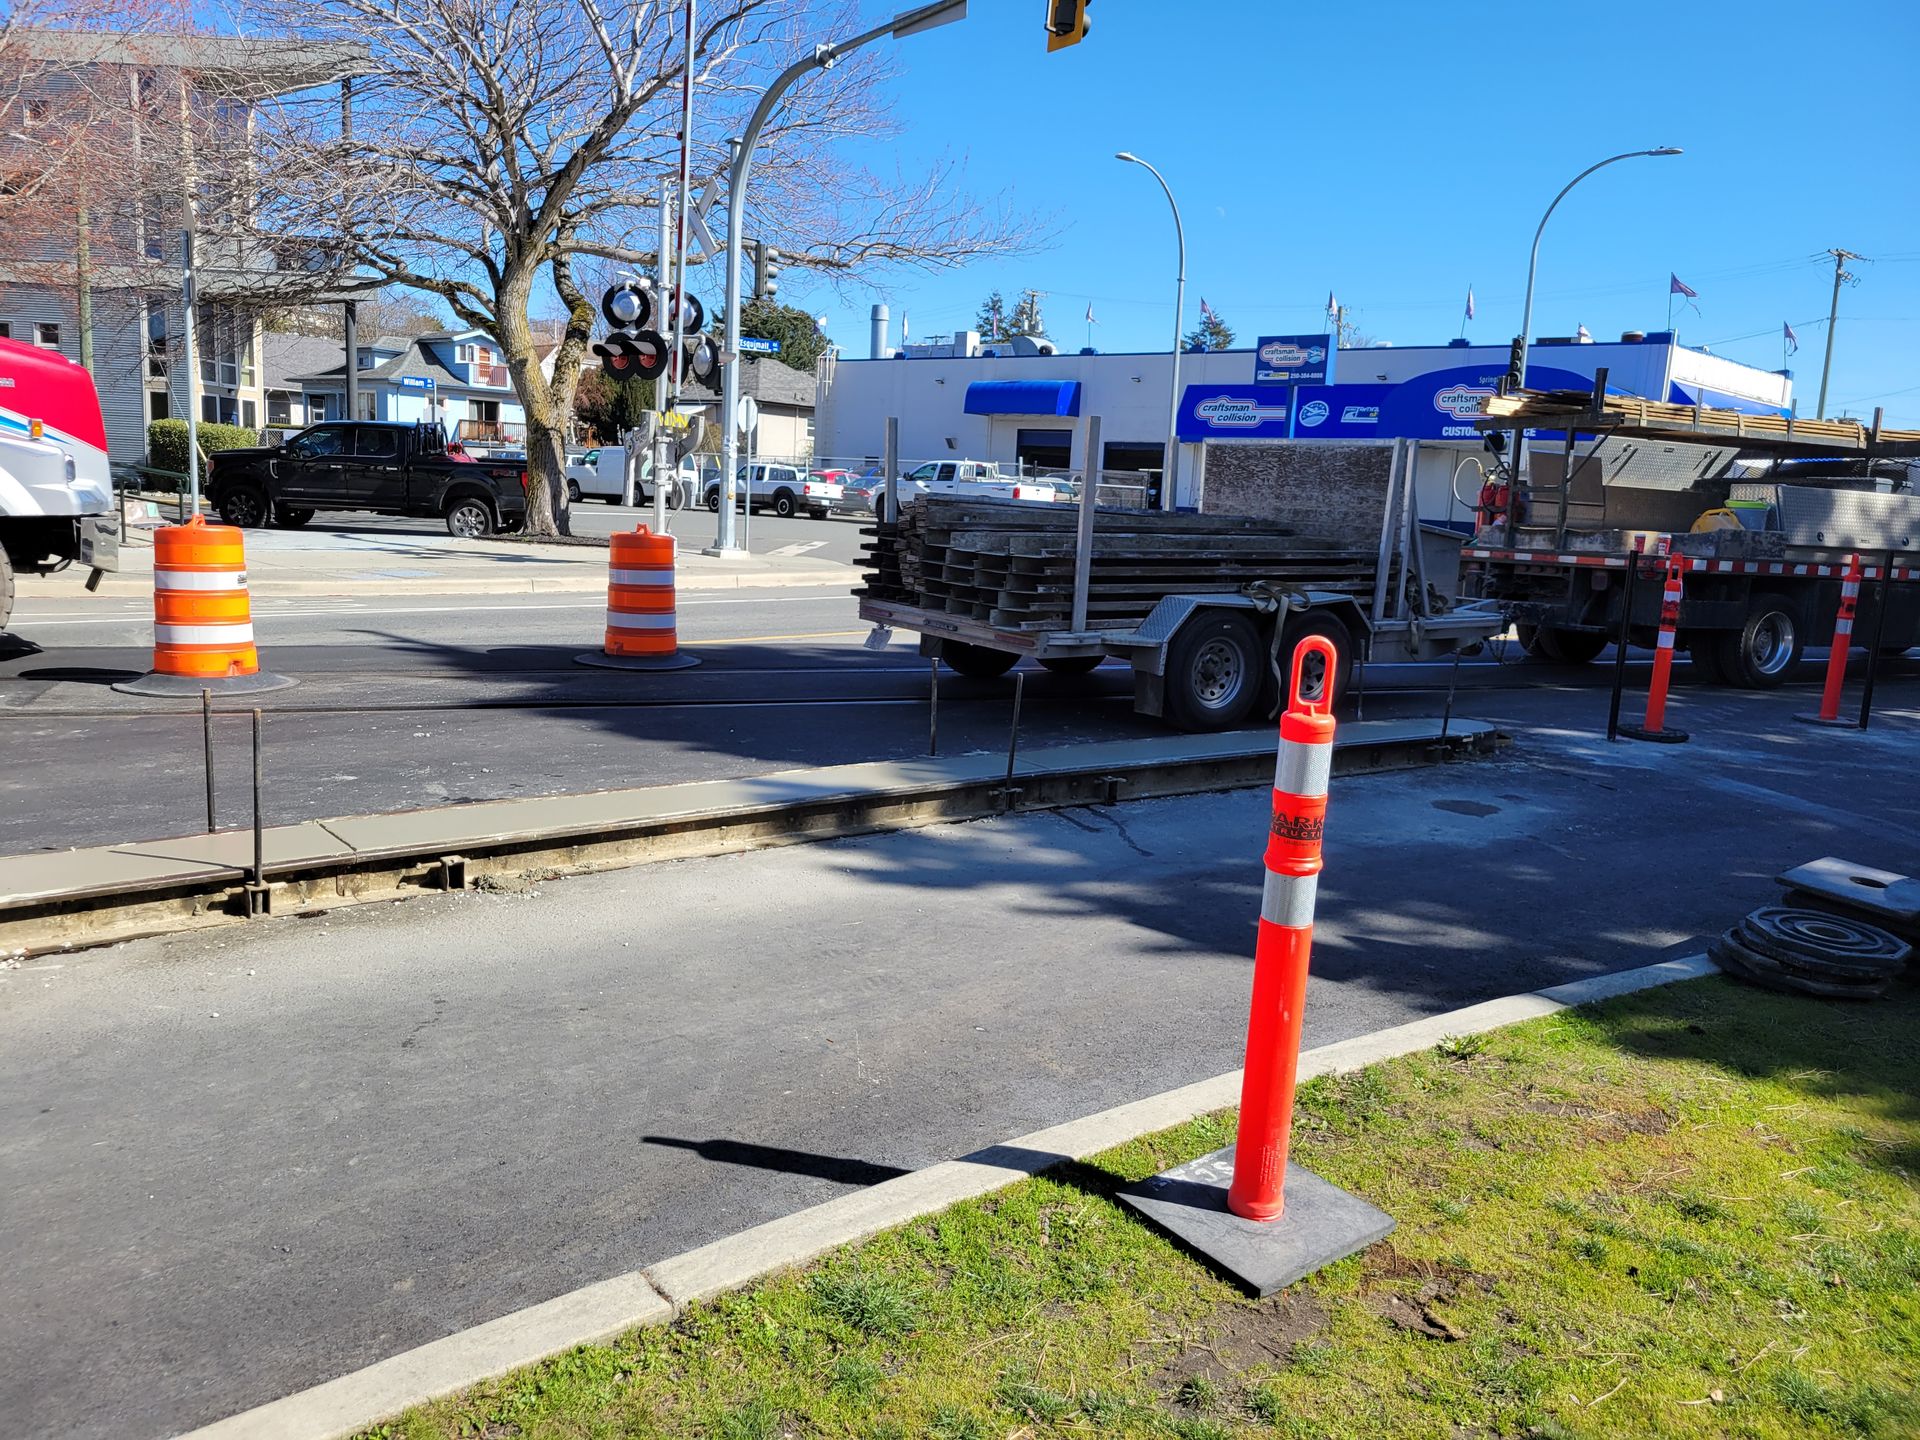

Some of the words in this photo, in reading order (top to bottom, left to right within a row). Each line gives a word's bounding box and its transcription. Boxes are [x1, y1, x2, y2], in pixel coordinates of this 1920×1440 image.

[1479, 376, 1499, 384] Spring
[1441, 393, 1483, 403] craftsma
[1202, 402, 1250, 412] craftsman
[1458, 404, 1480, 413] colli
[1217, 413, 1257, 422] collision
